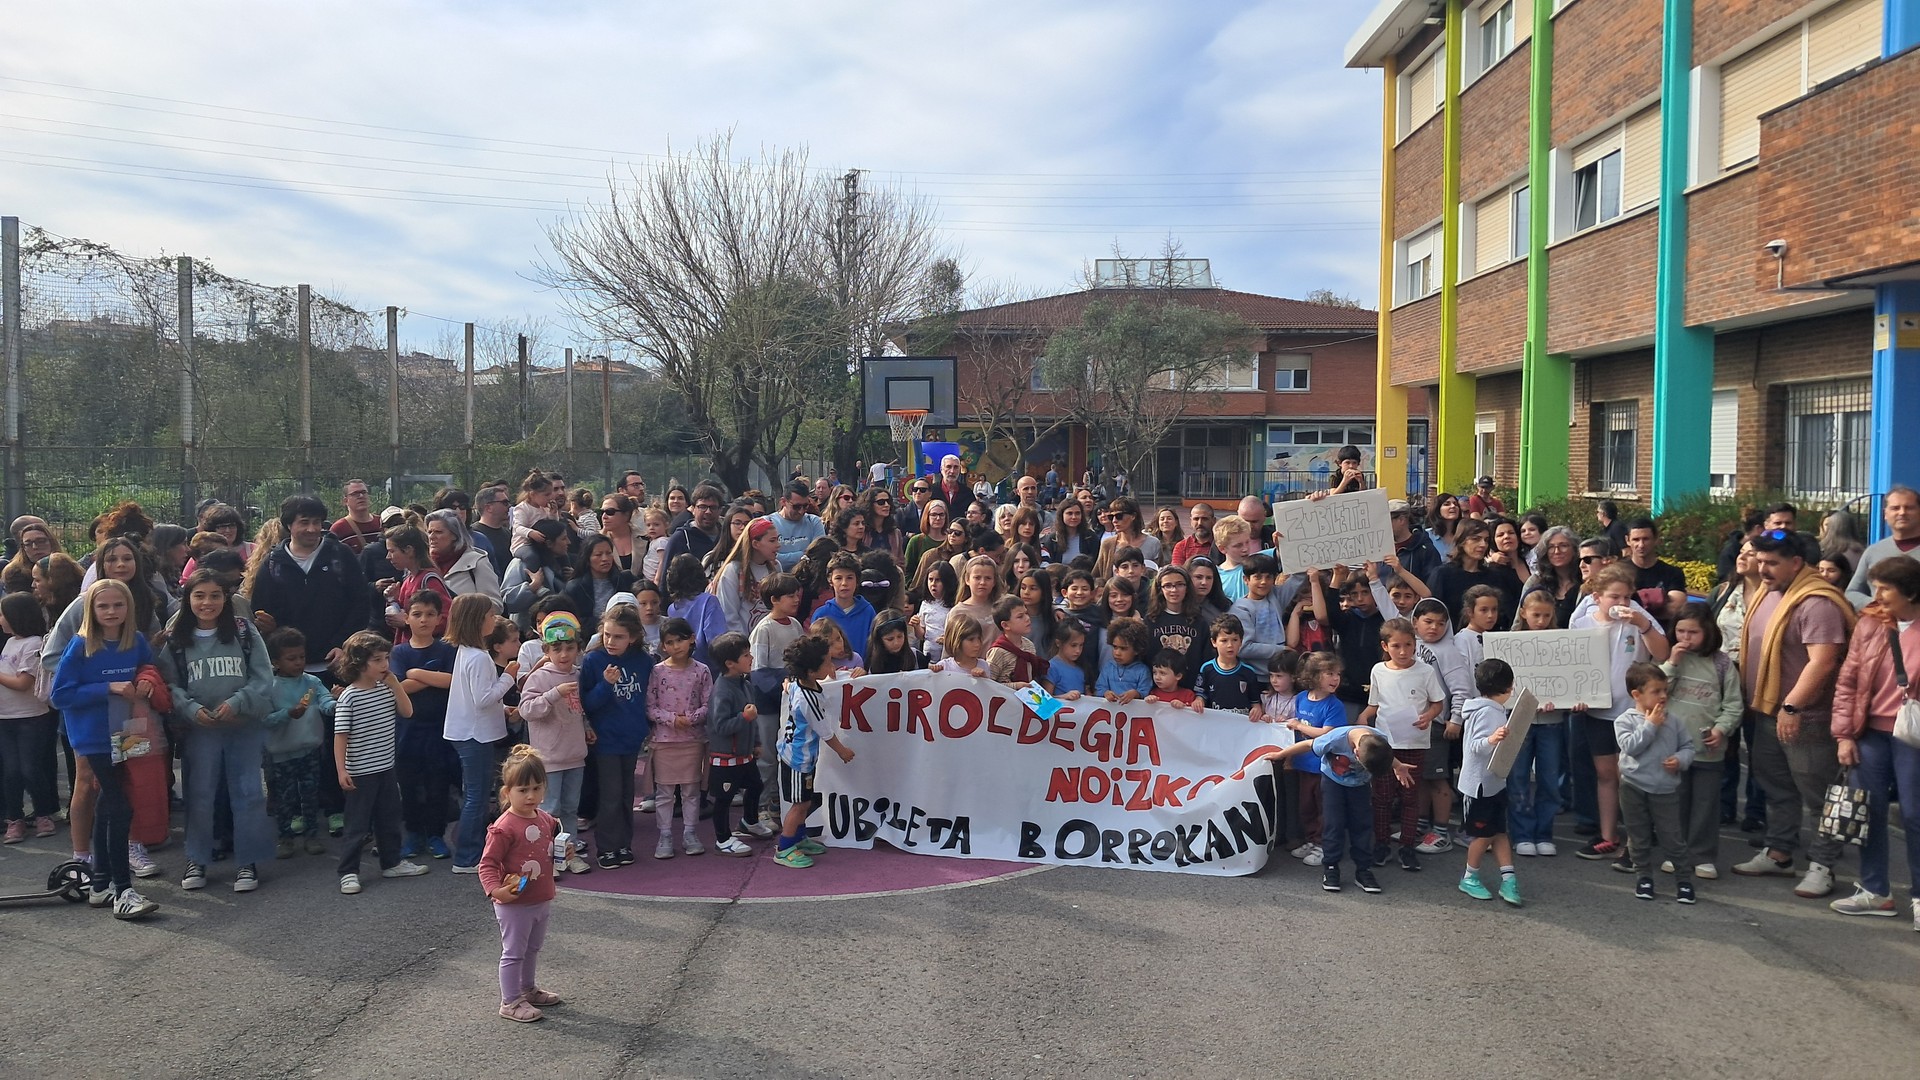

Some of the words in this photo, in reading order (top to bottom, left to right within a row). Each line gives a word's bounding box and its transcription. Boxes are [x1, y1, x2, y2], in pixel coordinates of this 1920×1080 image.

[1153, 624, 1198, 638] PALERMO
[101, 666, 137, 675] carhart
[187, 659, 203, 683] EW
[206, 656, 243, 678] YORK
